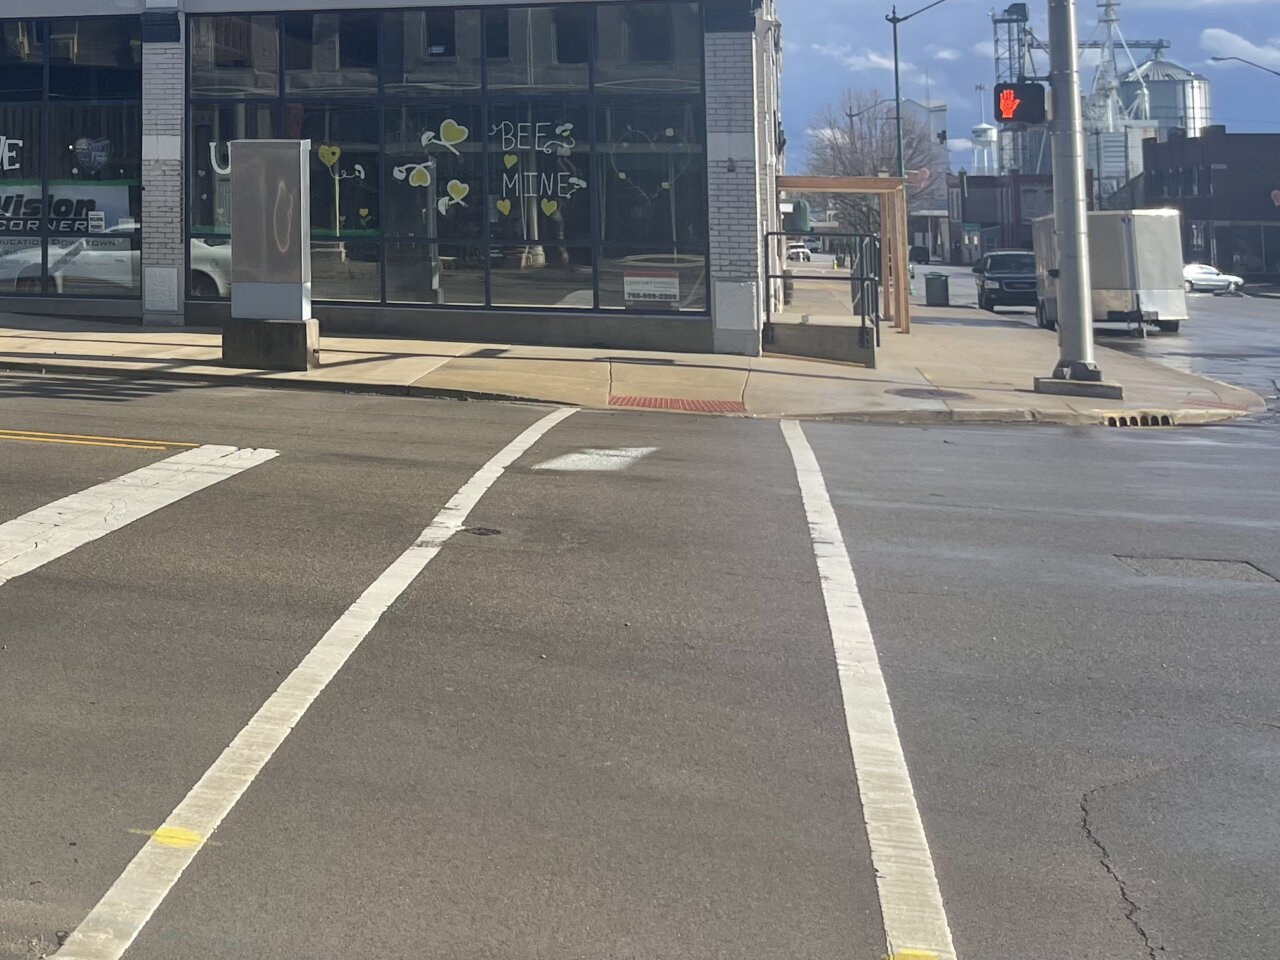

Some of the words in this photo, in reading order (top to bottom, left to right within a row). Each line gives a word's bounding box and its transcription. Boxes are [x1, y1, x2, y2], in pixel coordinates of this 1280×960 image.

[495, 121, 552, 153] BEE
[502, 172, 570, 198] MINE
[52, 239, 116, 247] DOWTOWN
